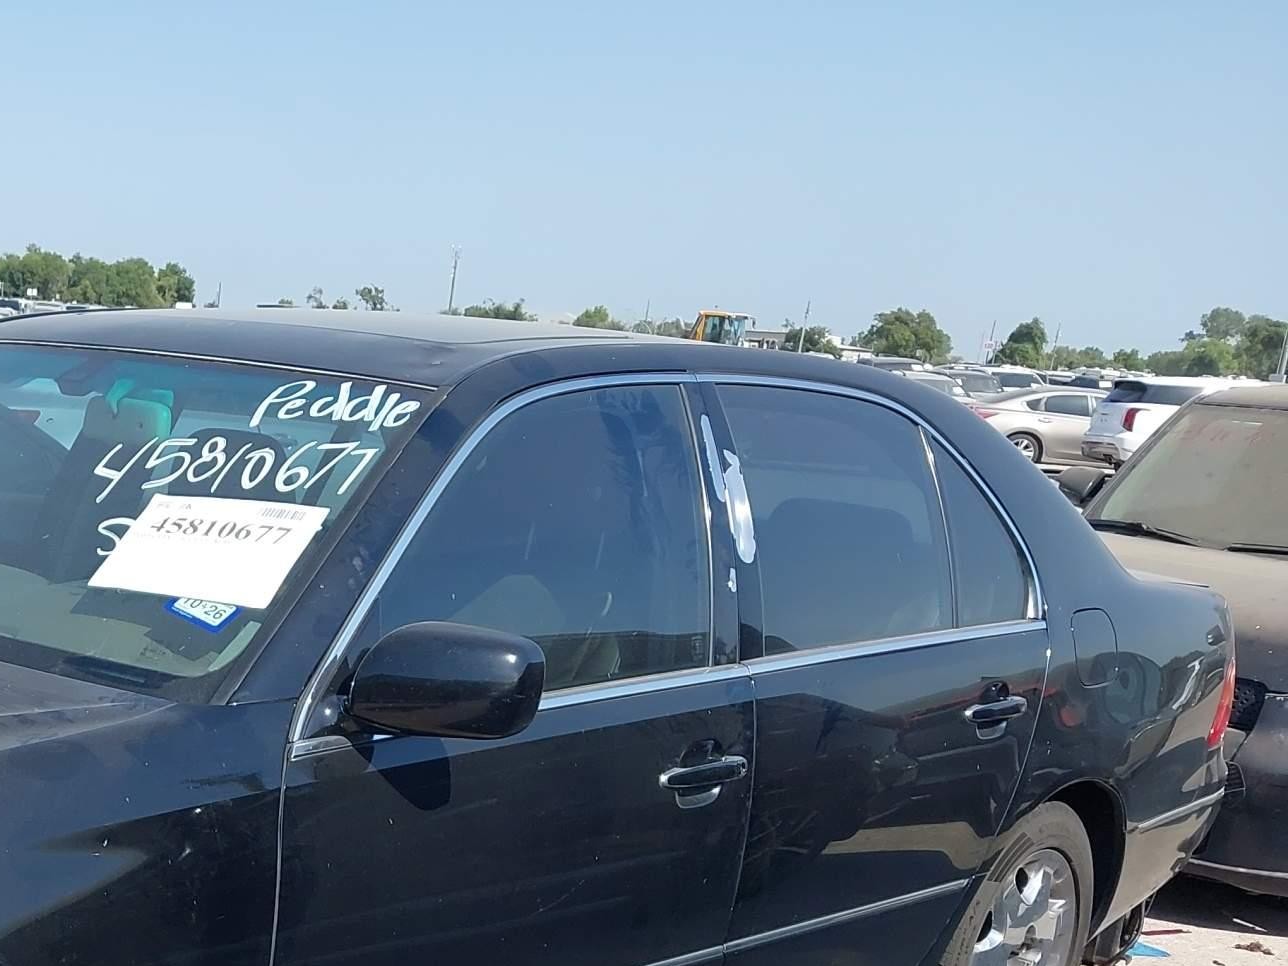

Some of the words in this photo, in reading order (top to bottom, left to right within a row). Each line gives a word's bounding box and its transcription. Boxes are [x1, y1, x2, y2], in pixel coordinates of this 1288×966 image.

[249, 380, 421, 432] Peddle
[93, 436, 380, 504] 45810677
[150, 516, 293, 545] 45810677
